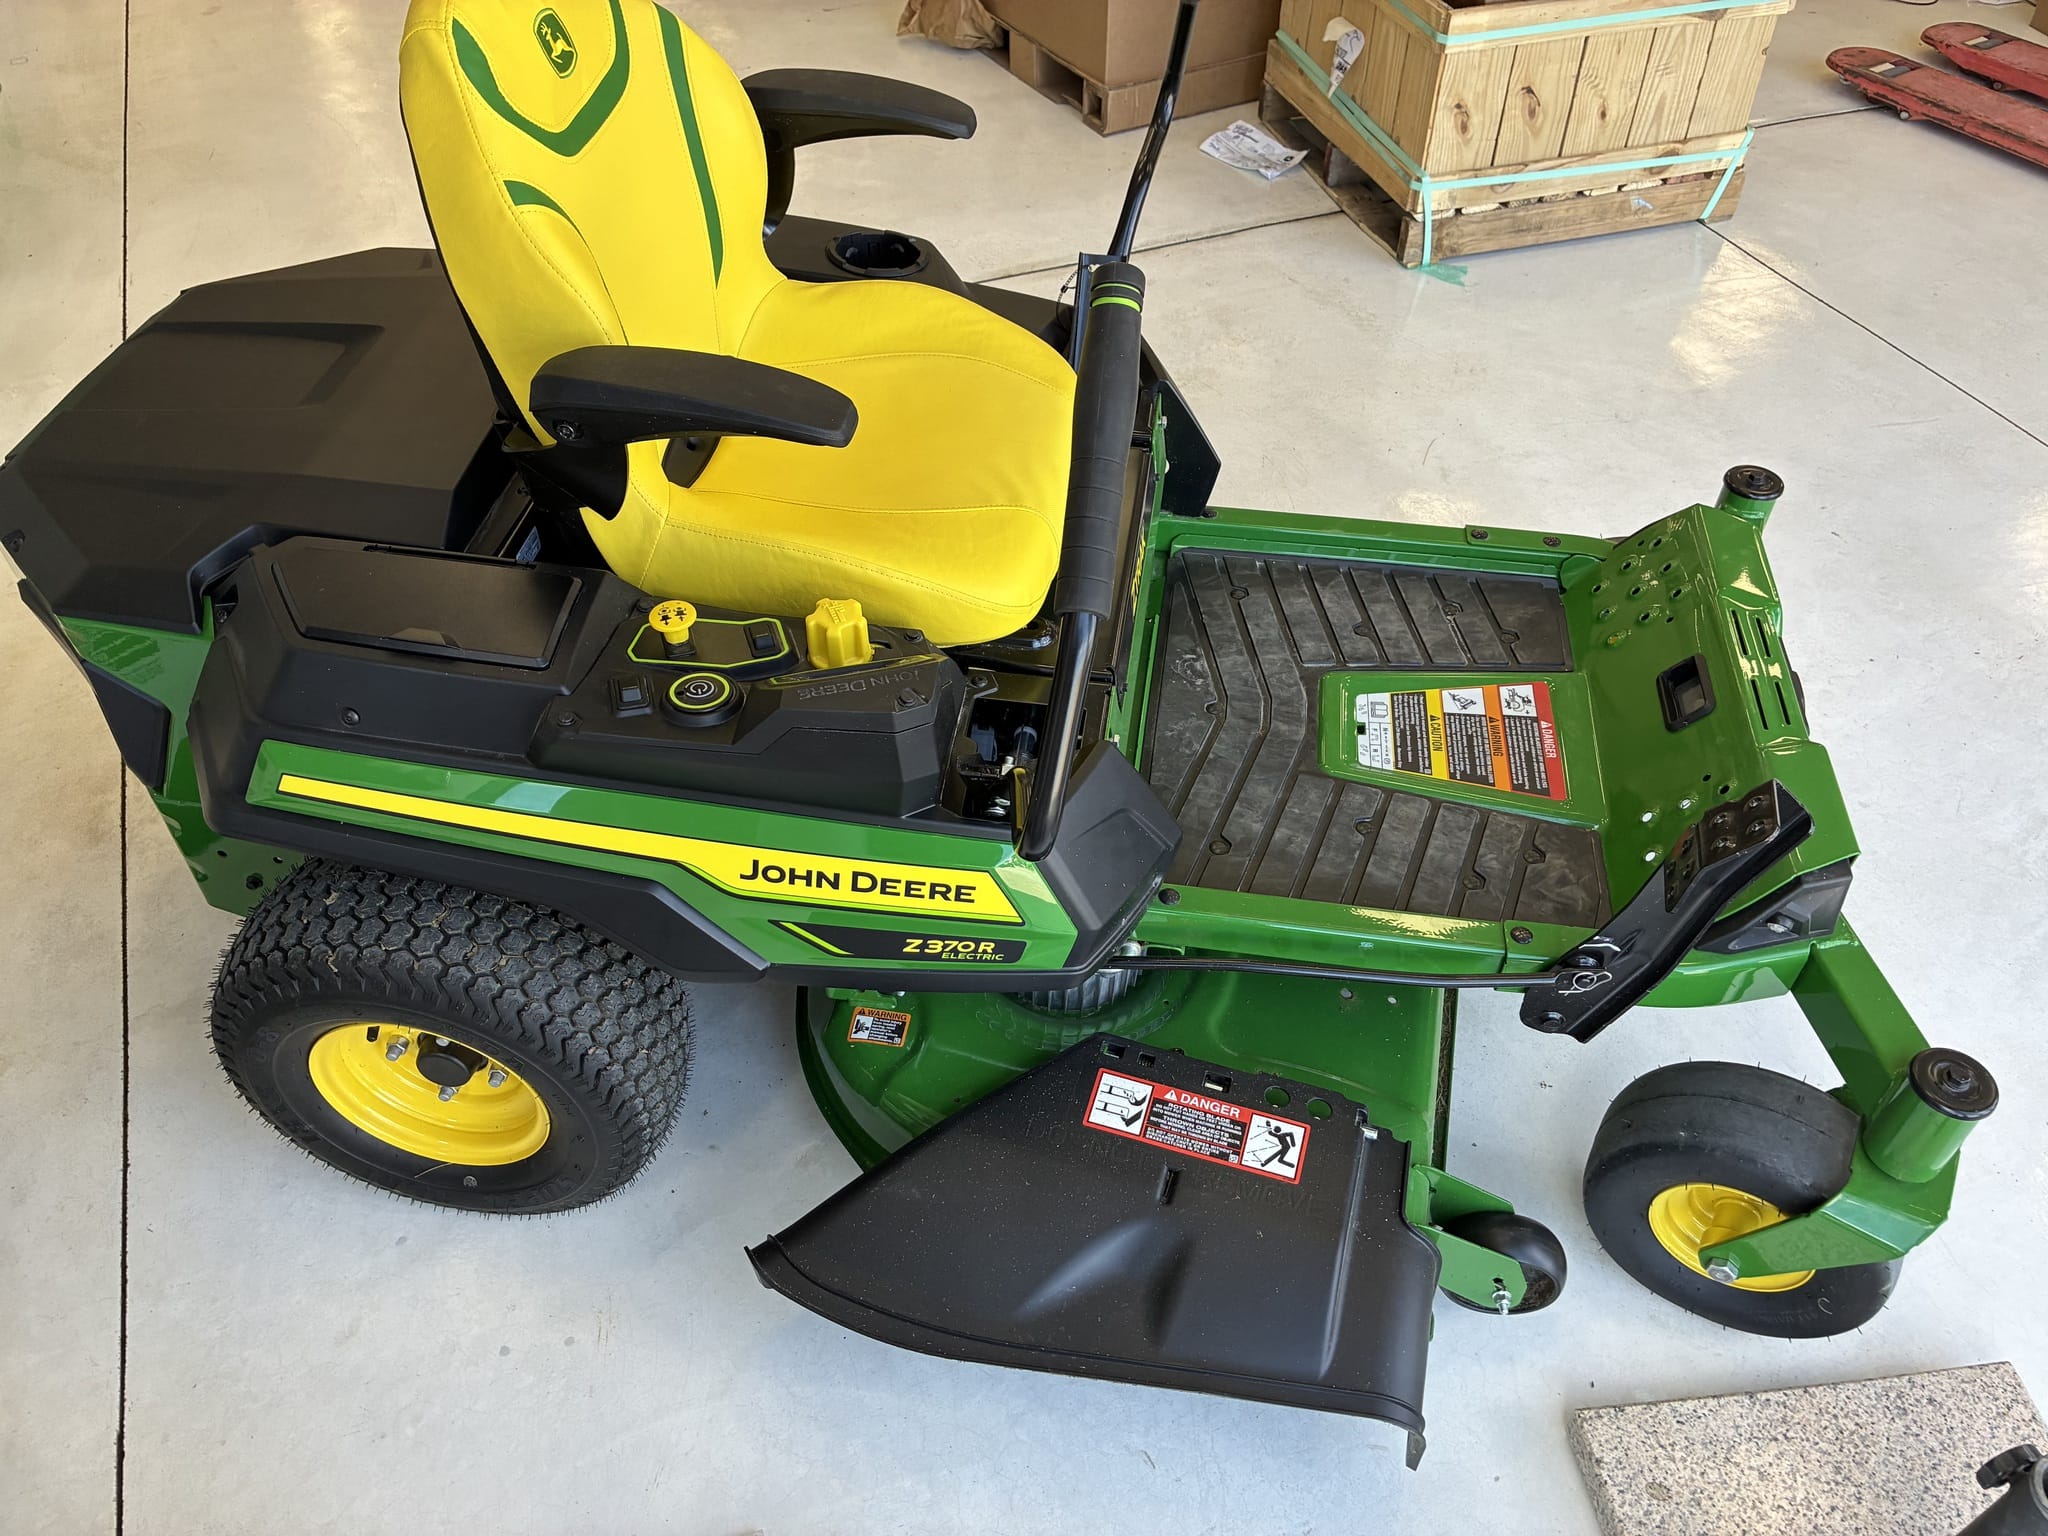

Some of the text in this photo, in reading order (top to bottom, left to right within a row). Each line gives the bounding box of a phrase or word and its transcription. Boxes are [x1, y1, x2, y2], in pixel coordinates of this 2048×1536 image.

[1430, 722, 1445, 752] CAUTION
[1489, 724, 1505, 757] WARNING
[1540, 727, 1557, 759] DANGER
[740, 859, 977, 903] JOHN DEERE
[941, 952, 1005, 962] ELECTRIC
[868, 1009, 907, 1020] WARNING
[1168, 1102, 1230, 1123] ROTATING BLADE
[1180, 1093, 1240, 1118] DANGER
[1163, 1115, 1229, 1138] THROWN OBJECTS
